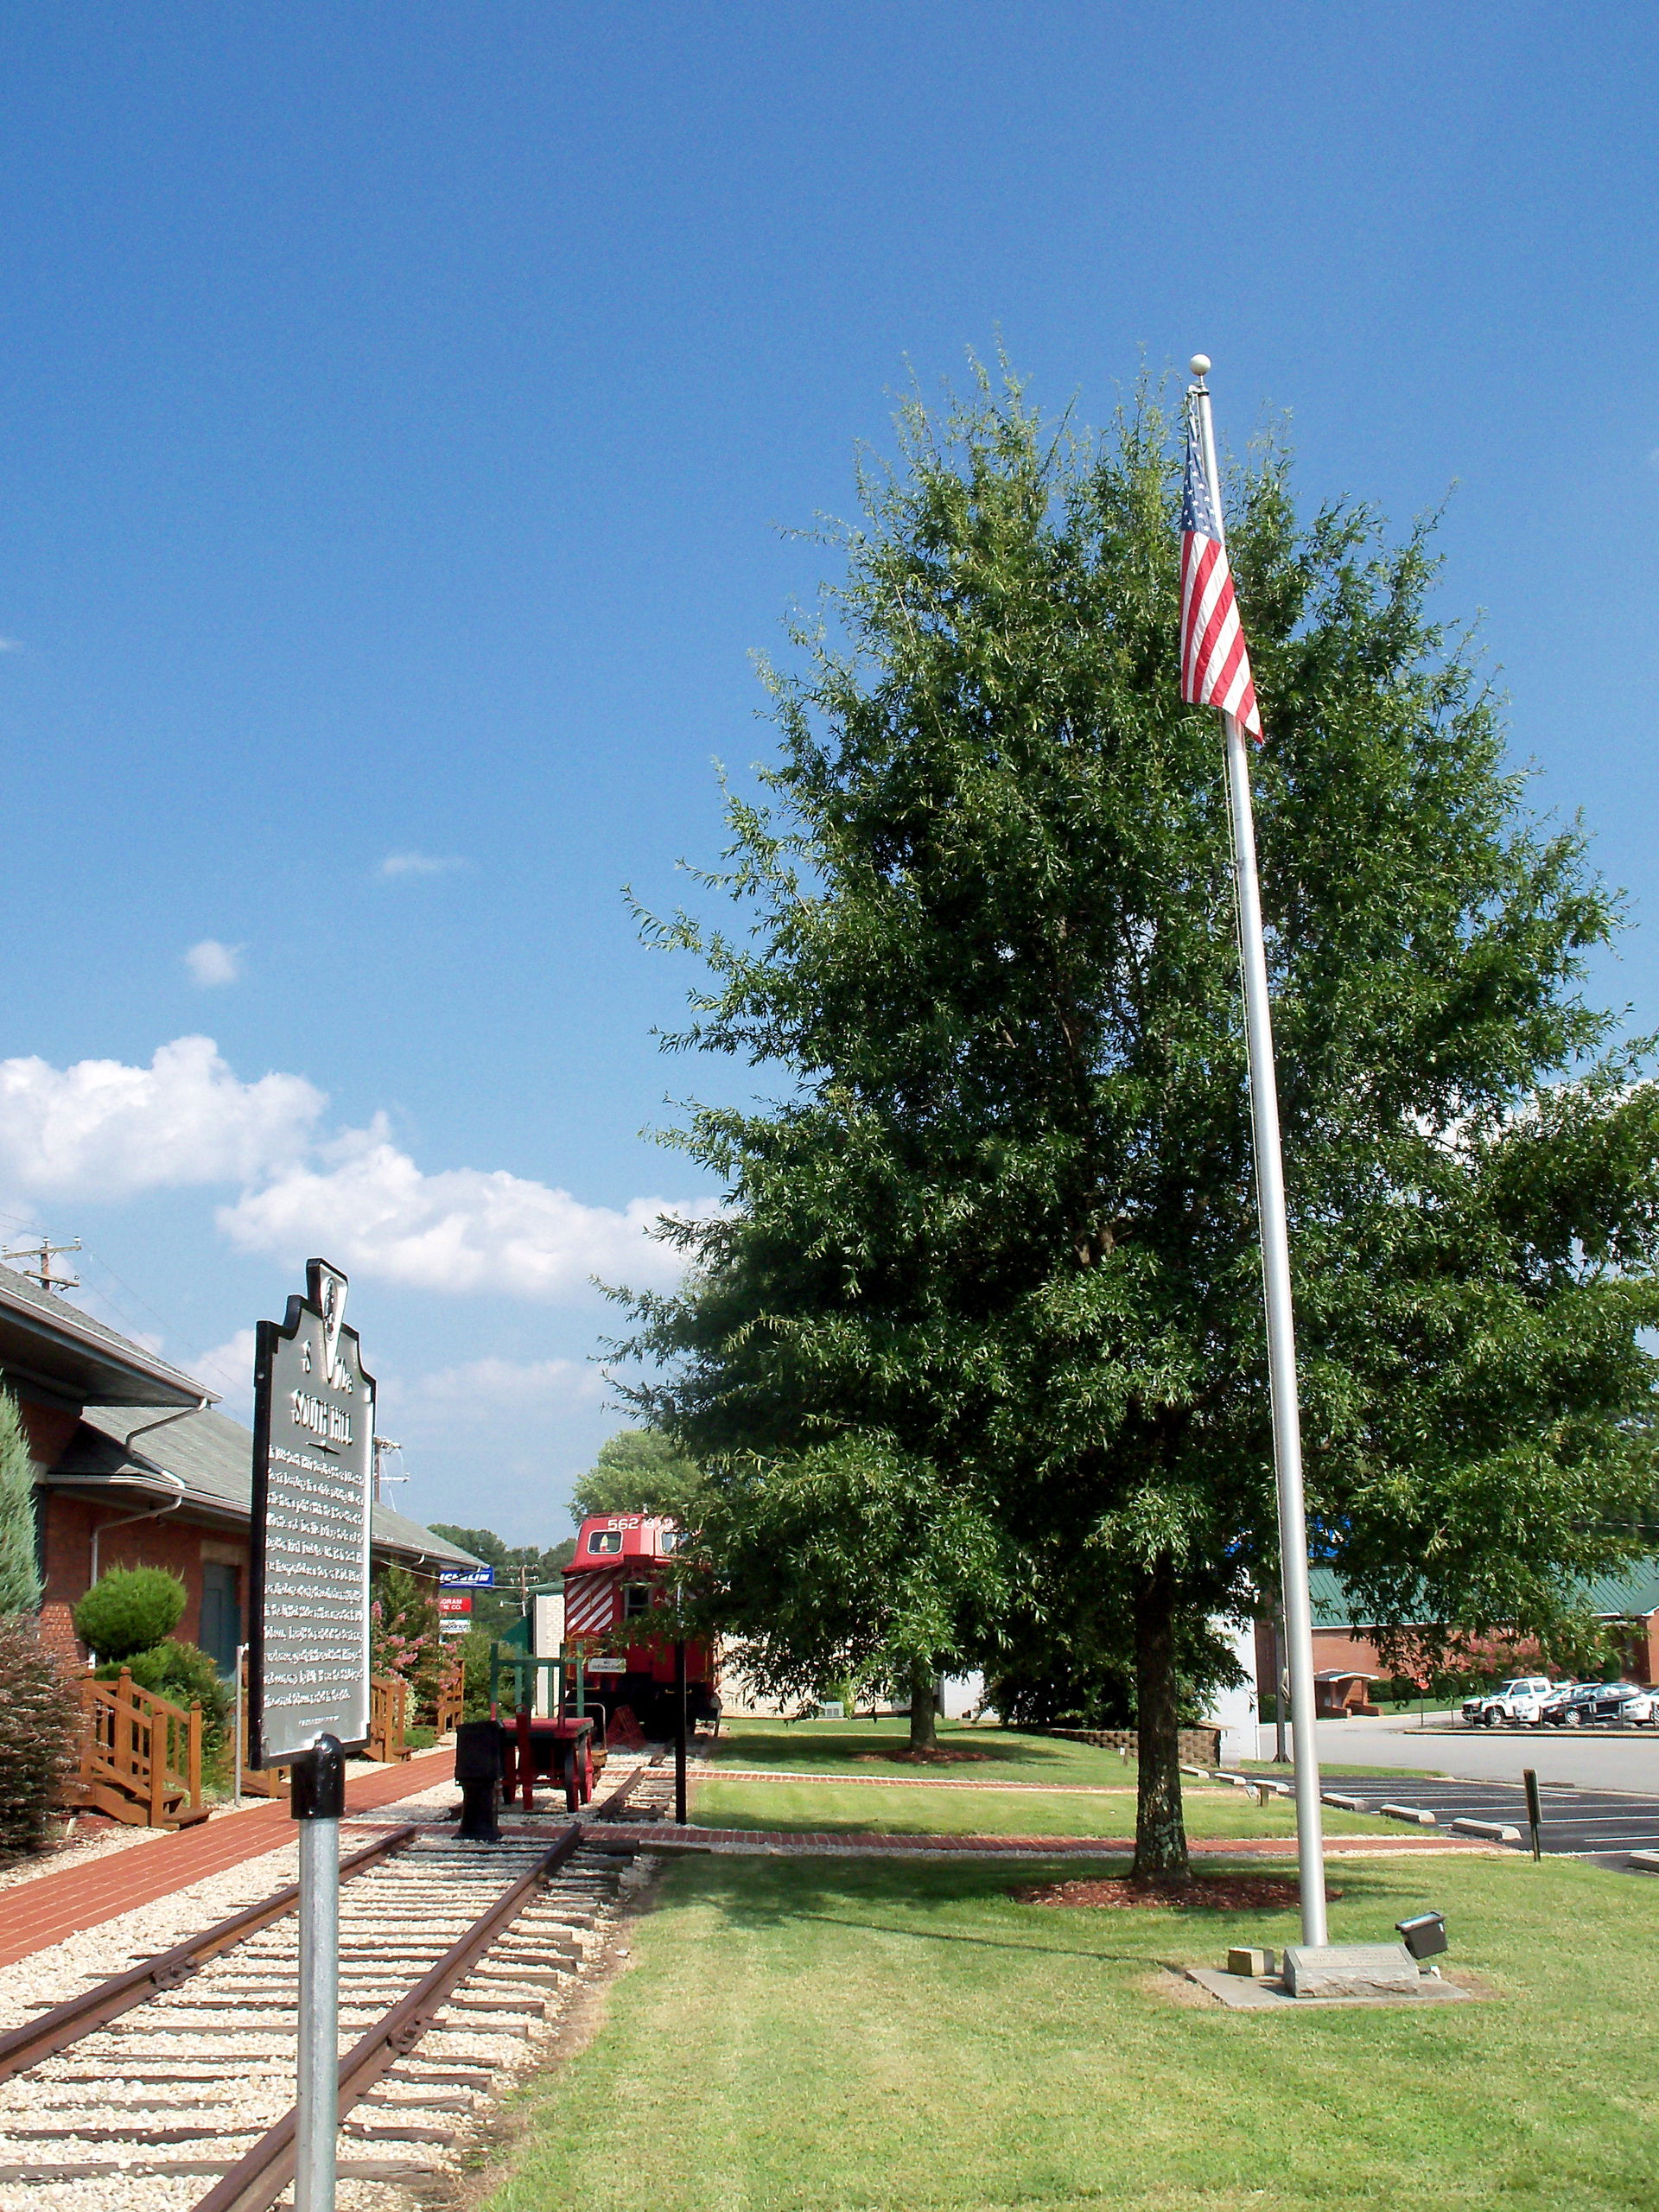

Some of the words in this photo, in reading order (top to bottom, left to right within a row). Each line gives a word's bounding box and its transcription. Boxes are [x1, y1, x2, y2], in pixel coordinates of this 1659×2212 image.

[290, 1389, 328, 1436] SOUTH
[329, 1404, 353, 1446] HILL
[607, 1517, 639, 1530] 562
[439, 1573, 490, 1582] ICHELIN
